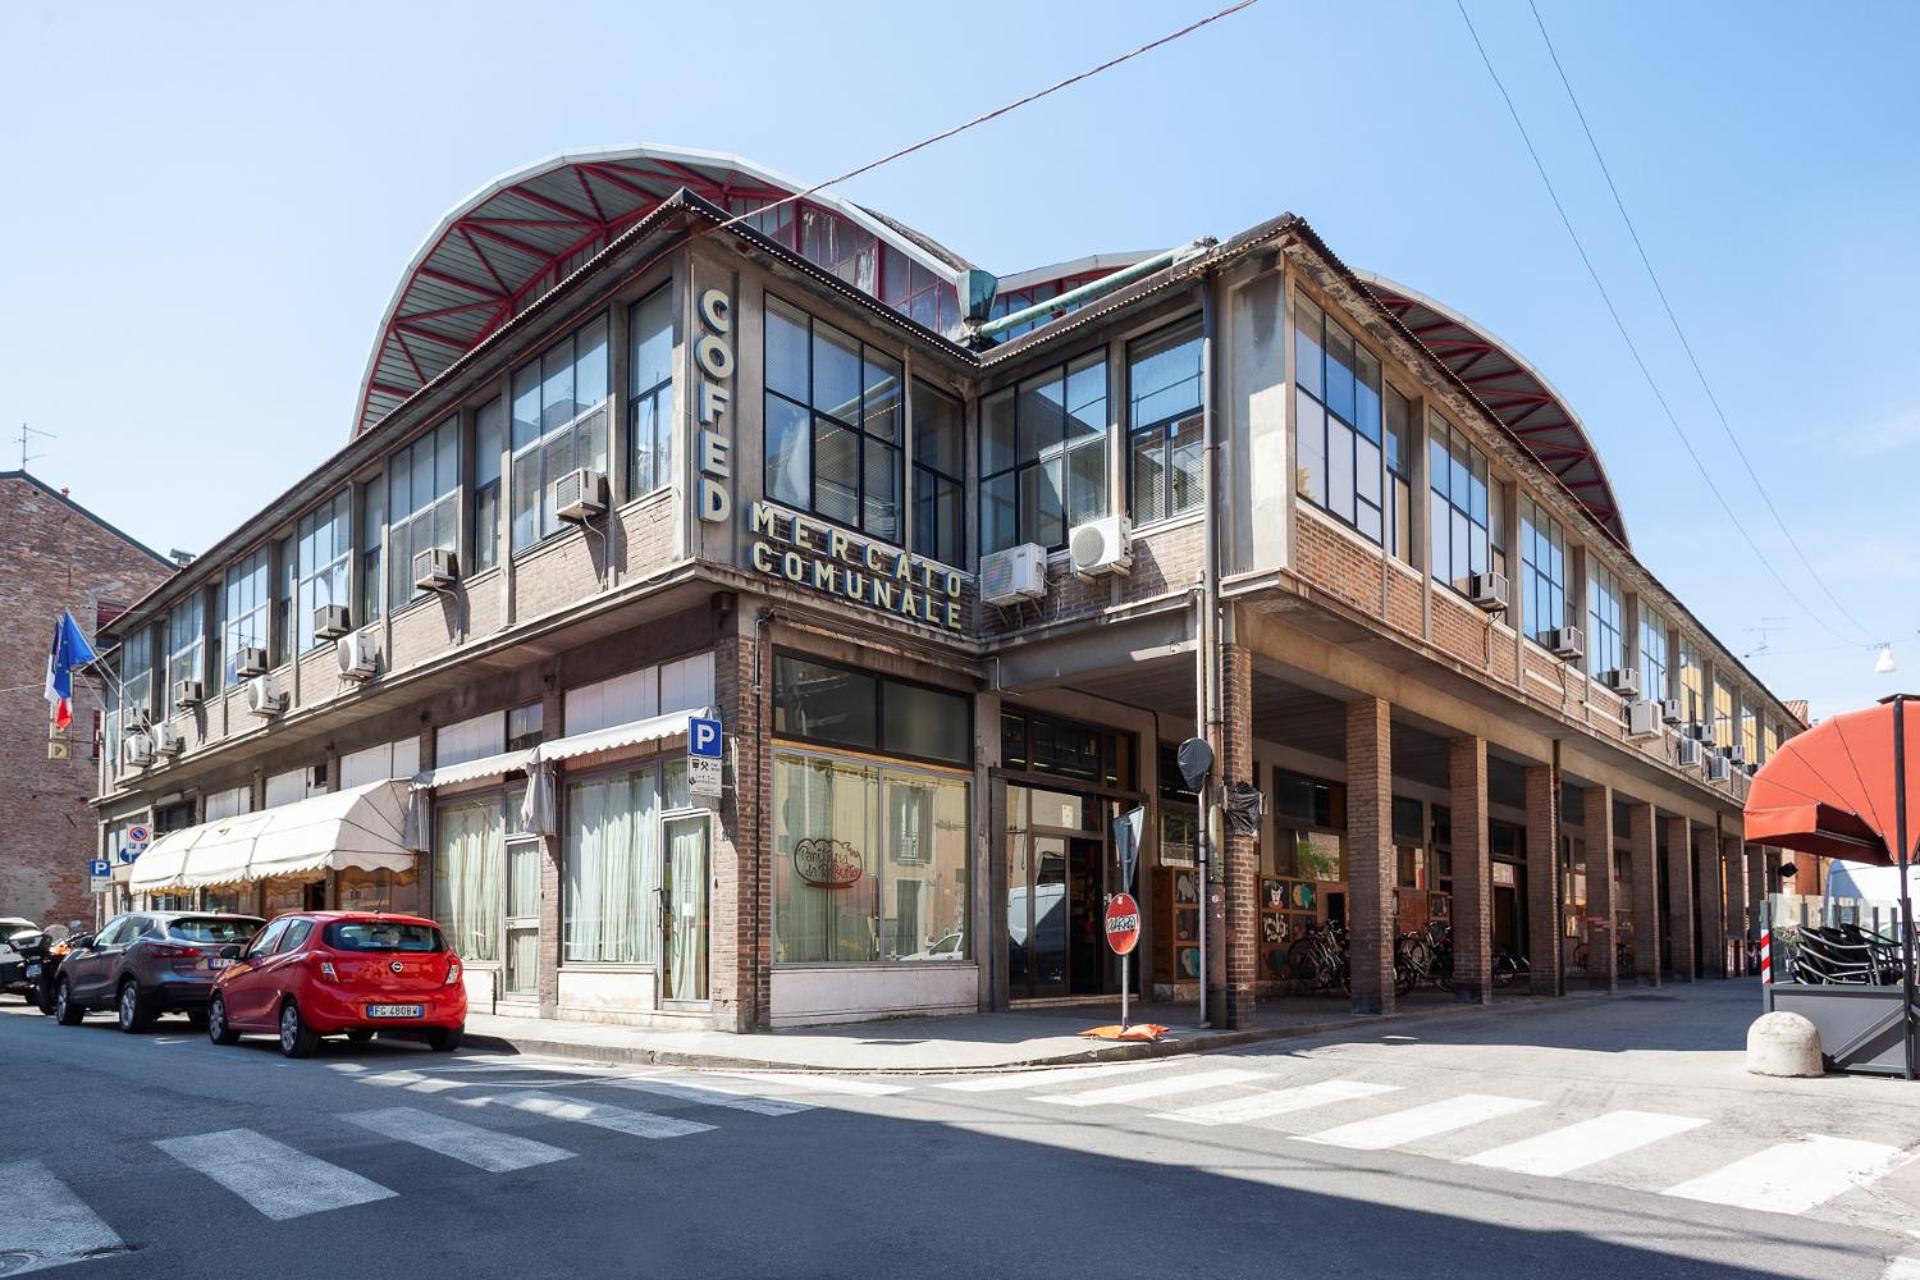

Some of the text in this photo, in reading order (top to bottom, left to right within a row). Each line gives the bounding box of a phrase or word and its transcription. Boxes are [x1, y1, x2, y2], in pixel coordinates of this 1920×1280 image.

[696, 288, 735, 523] COFED
[750, 502, 961, 598] MERCATO
[751, 540, 962, 630] COMUNALE
[697, 724, 715, 750] P
[95, 862, 107, 874] P
